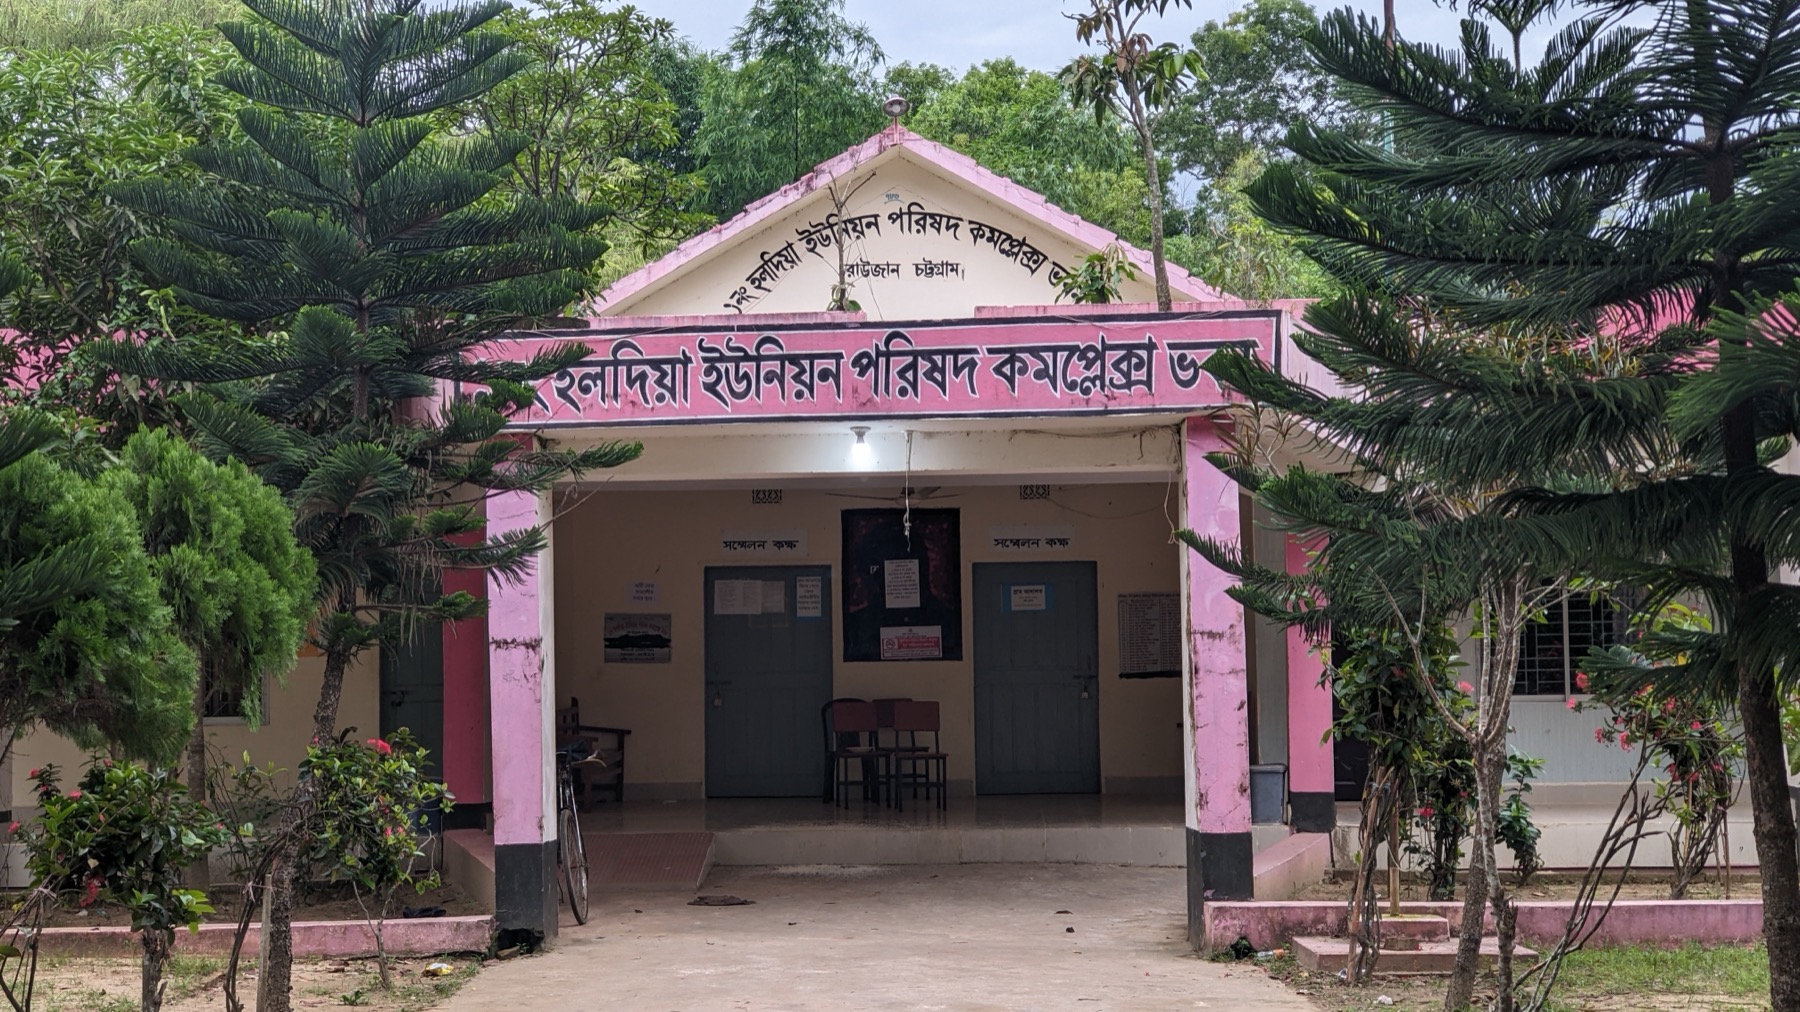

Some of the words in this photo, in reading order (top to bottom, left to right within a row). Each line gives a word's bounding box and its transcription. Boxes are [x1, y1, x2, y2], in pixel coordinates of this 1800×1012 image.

[745, 240, 803, 292] হলদিয়া
[795, 213, 881, 258] ইউনিয়ন
[888, 202, 963, 241] পরিষদ
[845, 257, 901, 279] রাউজান
[552, 339, 695, 417] হলদিয়া
[698, 335, 848, 412] ইউনিয়ন
[851, 330, 981, 402] পরিষদ
